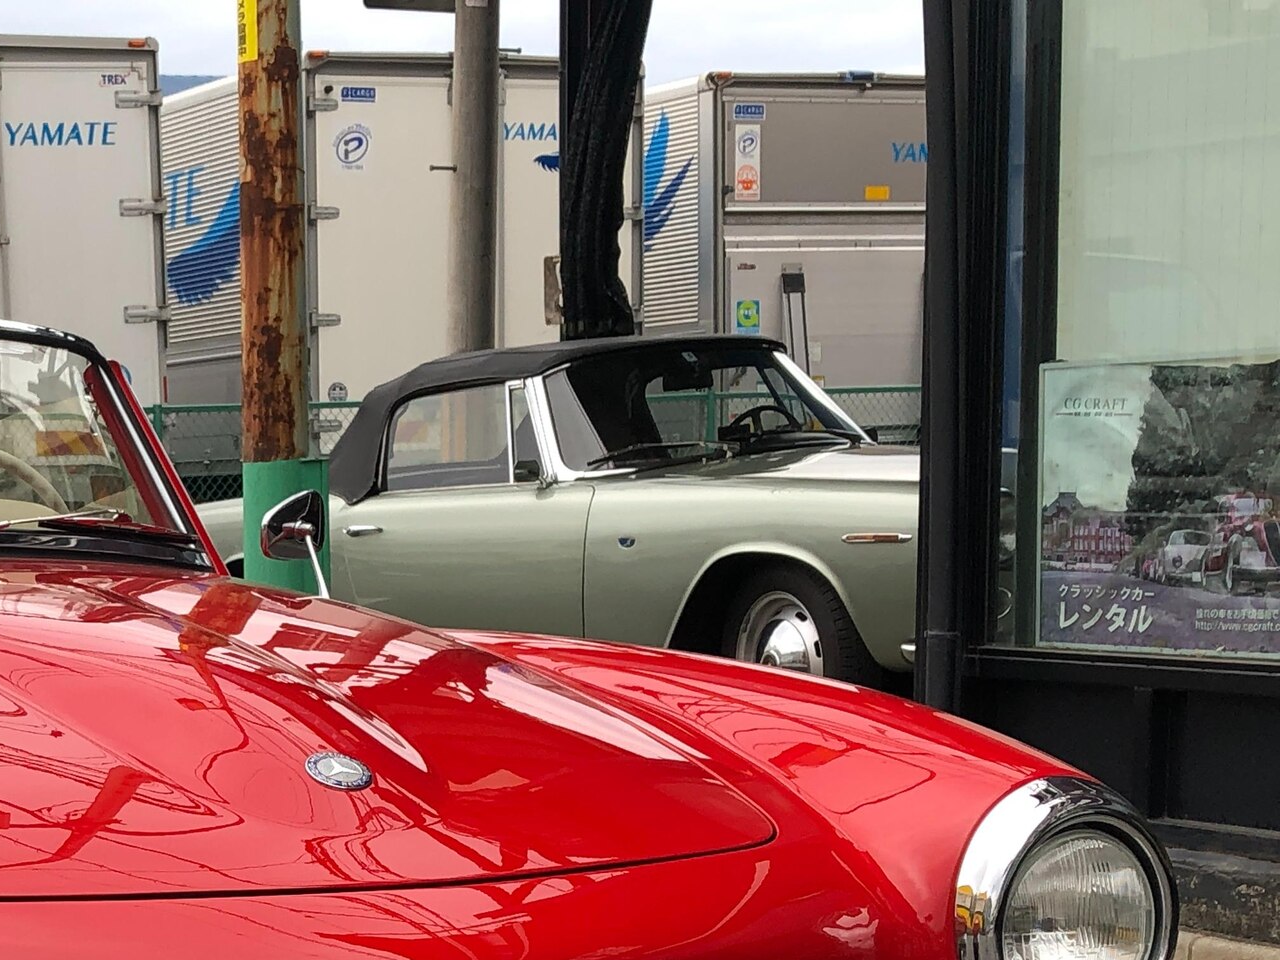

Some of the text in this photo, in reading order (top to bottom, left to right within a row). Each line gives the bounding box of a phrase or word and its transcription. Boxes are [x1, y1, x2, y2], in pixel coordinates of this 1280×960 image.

[101, 74, 127, 85] TREX
[4, 121, 118, 146] YAMATE
[503, 122, 558, 141] YAMA
[1063, 397, 1128, 411] CG CRAFT
[1059, 583, 1155, 601] クラッシックカー
[1059, 601, 1154, 633] レンタル
